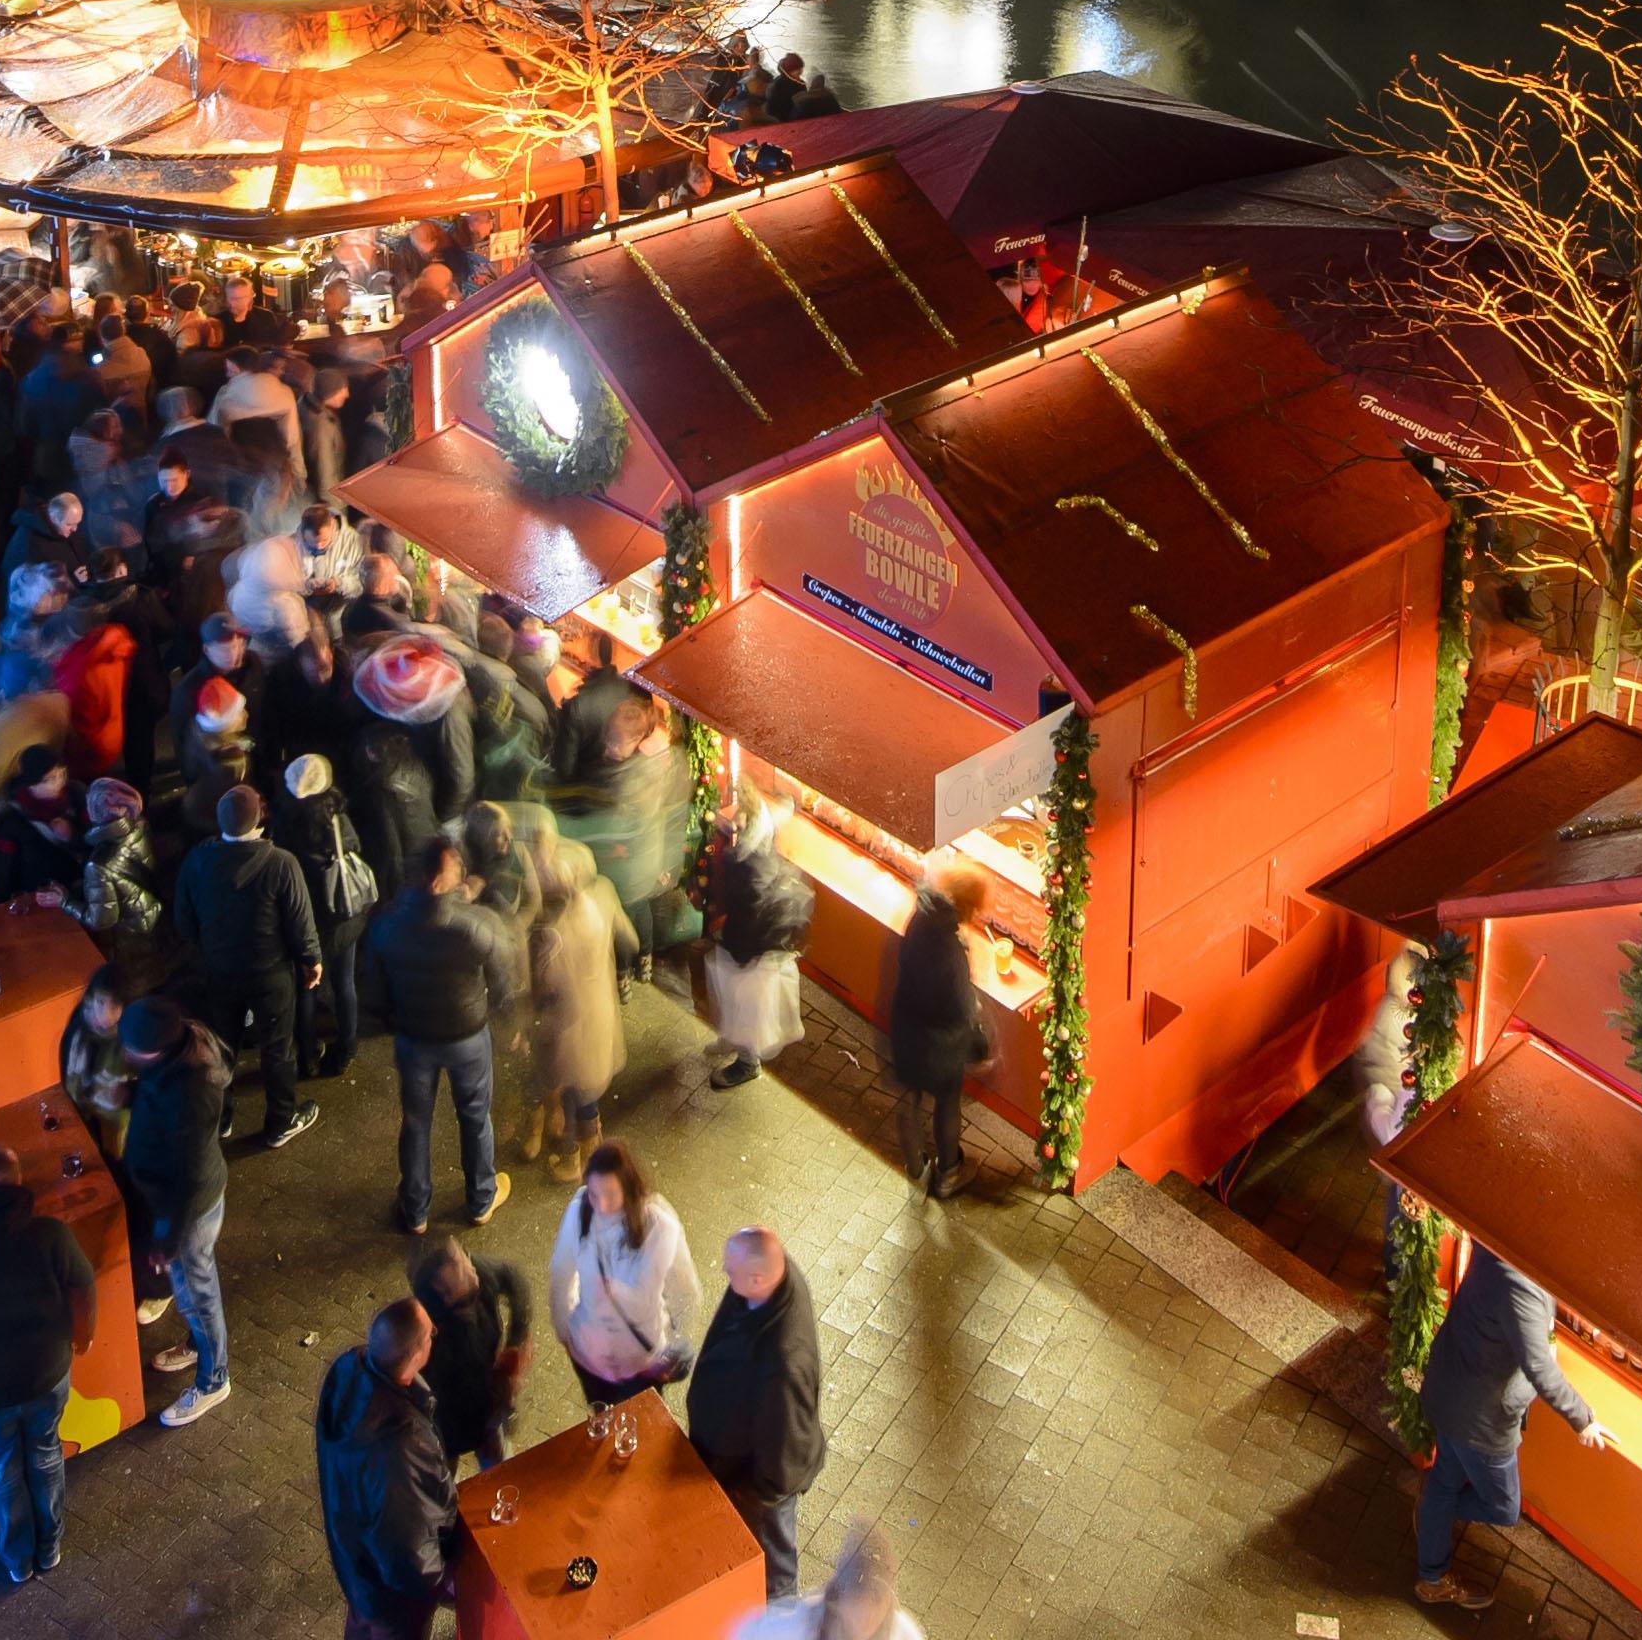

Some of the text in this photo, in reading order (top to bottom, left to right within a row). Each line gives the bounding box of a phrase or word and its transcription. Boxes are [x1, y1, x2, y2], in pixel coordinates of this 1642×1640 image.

[1358, 394, 1483, 459] Feuerzangenbowle
[848, 511, 959, 588] FEUERZANGEN
[865, 547, 941, 610] BOWLE
[808, 579, 842, 606] Crepes
[851, 606, 901, 640] Mandeln
[911, 636, 986, 685] Schneeballen
